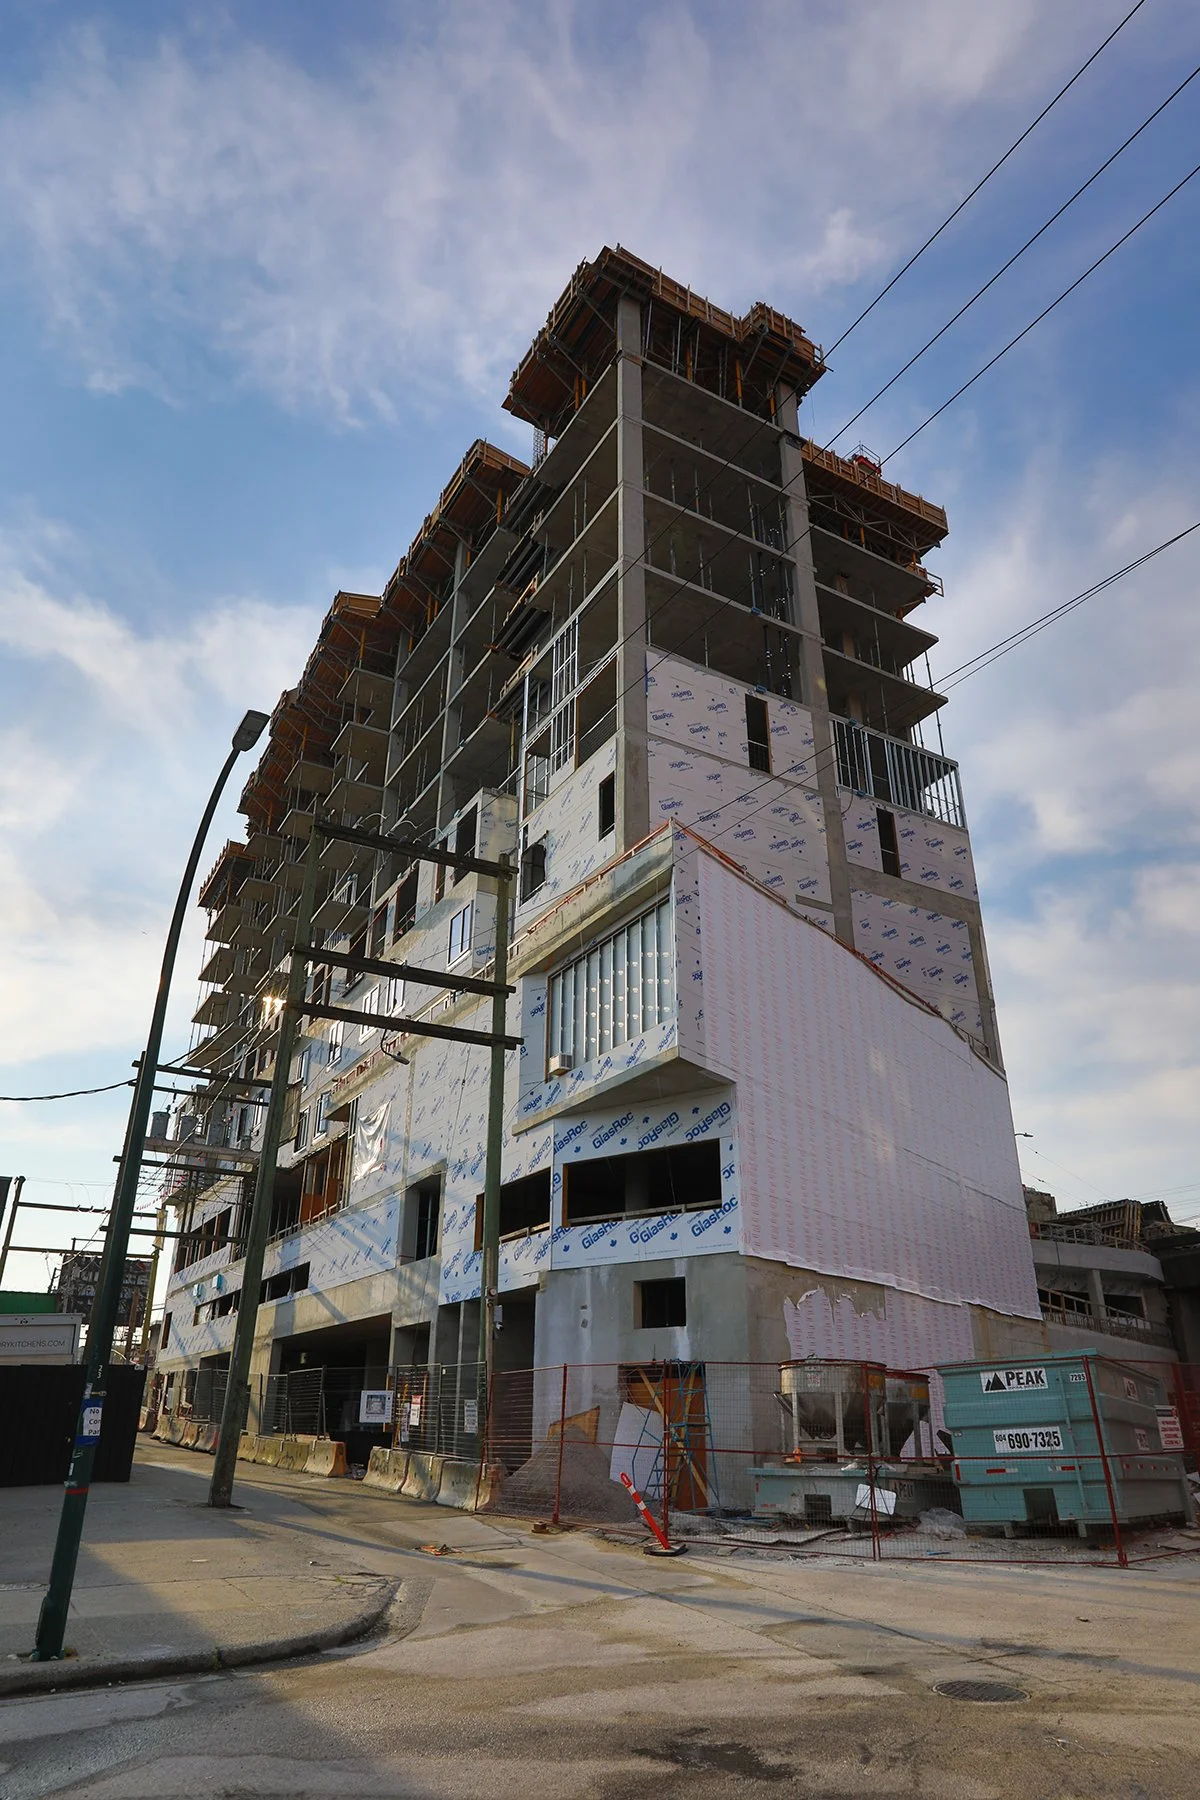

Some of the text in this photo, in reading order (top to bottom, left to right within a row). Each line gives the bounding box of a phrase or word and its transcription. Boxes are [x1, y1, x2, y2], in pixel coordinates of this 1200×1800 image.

[657, 1024, 676, 1052] lasRoc
[626, 1039, 645, 1067] GlasRoc
[523, 1094, 543, 1113] asRoc
[592, 1112, 634, 1149] GlasRoc
[638, 1111, 680, 1150] GlasRoc
[685, 1102, 731, 1142] GlasRoc
[691, 1197, 739, 1237] GlasRoc
[0, 1340, 65, 1348] RYKITCHENS.COM
[1005, 1370, 1045, 1386] PEAK
[995, 1431, 1061, 1449] 604 690-7325
